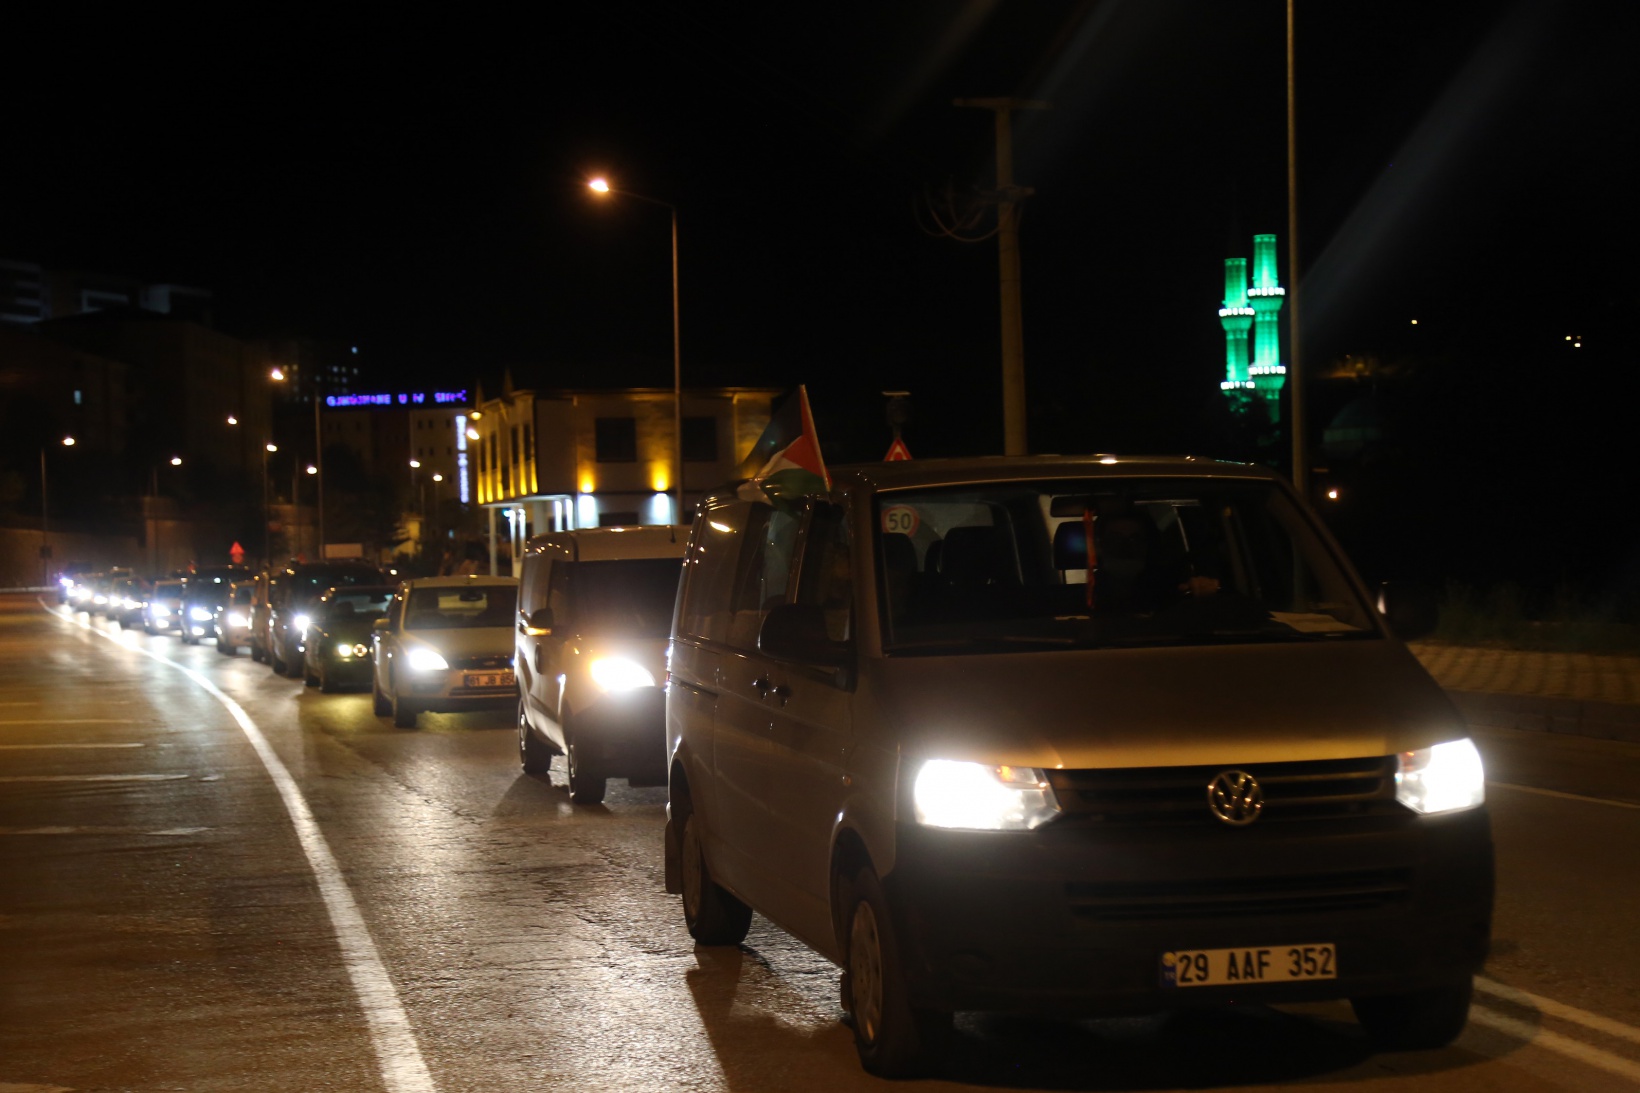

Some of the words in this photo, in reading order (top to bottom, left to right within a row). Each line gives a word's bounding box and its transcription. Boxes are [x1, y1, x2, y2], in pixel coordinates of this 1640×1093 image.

[888, 513, 911, 530] 50
[1179, 953, 1209, 983] 29
[1227, 950, 1271, 981] AAF
[1288, 947, 1333, 977] 352
